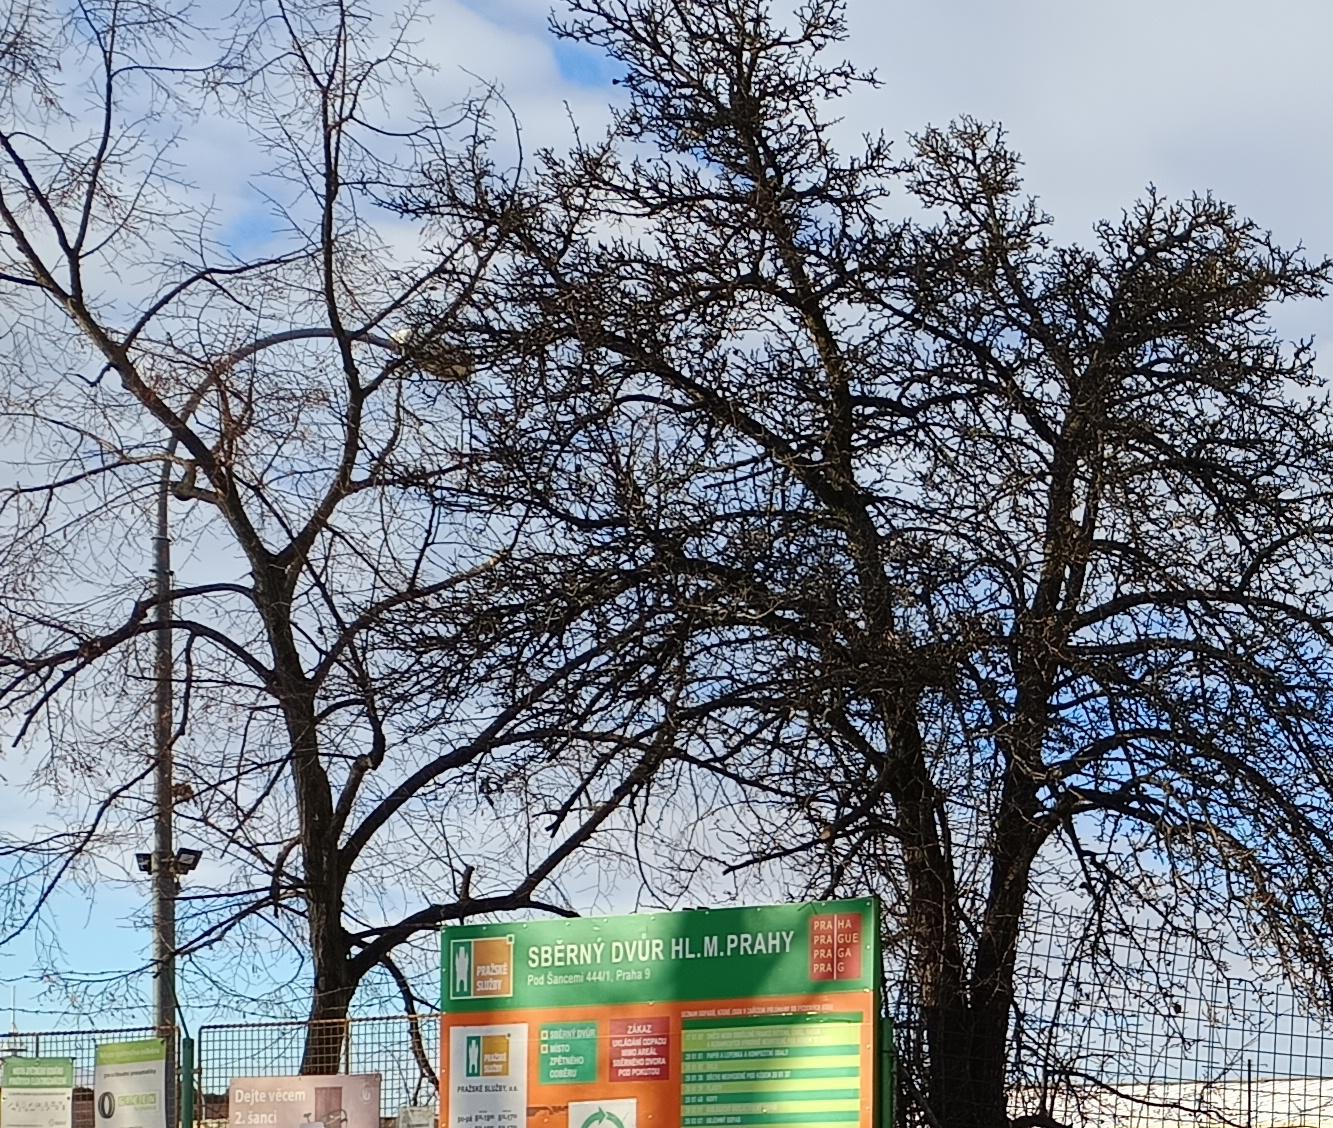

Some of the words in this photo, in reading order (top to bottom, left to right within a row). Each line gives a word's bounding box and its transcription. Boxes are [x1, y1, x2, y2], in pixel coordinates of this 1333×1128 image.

[813, 919, 833, 932] PRA
[813, 933, 833, 946] PRA
[528, 937, 606, 969] SBĚRNÝ
[611, 932, 665, 963] DVŮR
[813, 947, 833, 960] PRA
[813, 962, 833, 974] PRA
[527, 973, 544, 987] Pod
[546, 969, 585, 986] Šancemi
[616, 968, 641, 981] Praha
[644, 968, 651, 979] 9
[234, 1088, 266, 1106] Dejte
[267, 1088, 306, 1102] věcem
[233, 1113, 246, 1124] 2.
[247, 1109, 277, 1124] šanci
